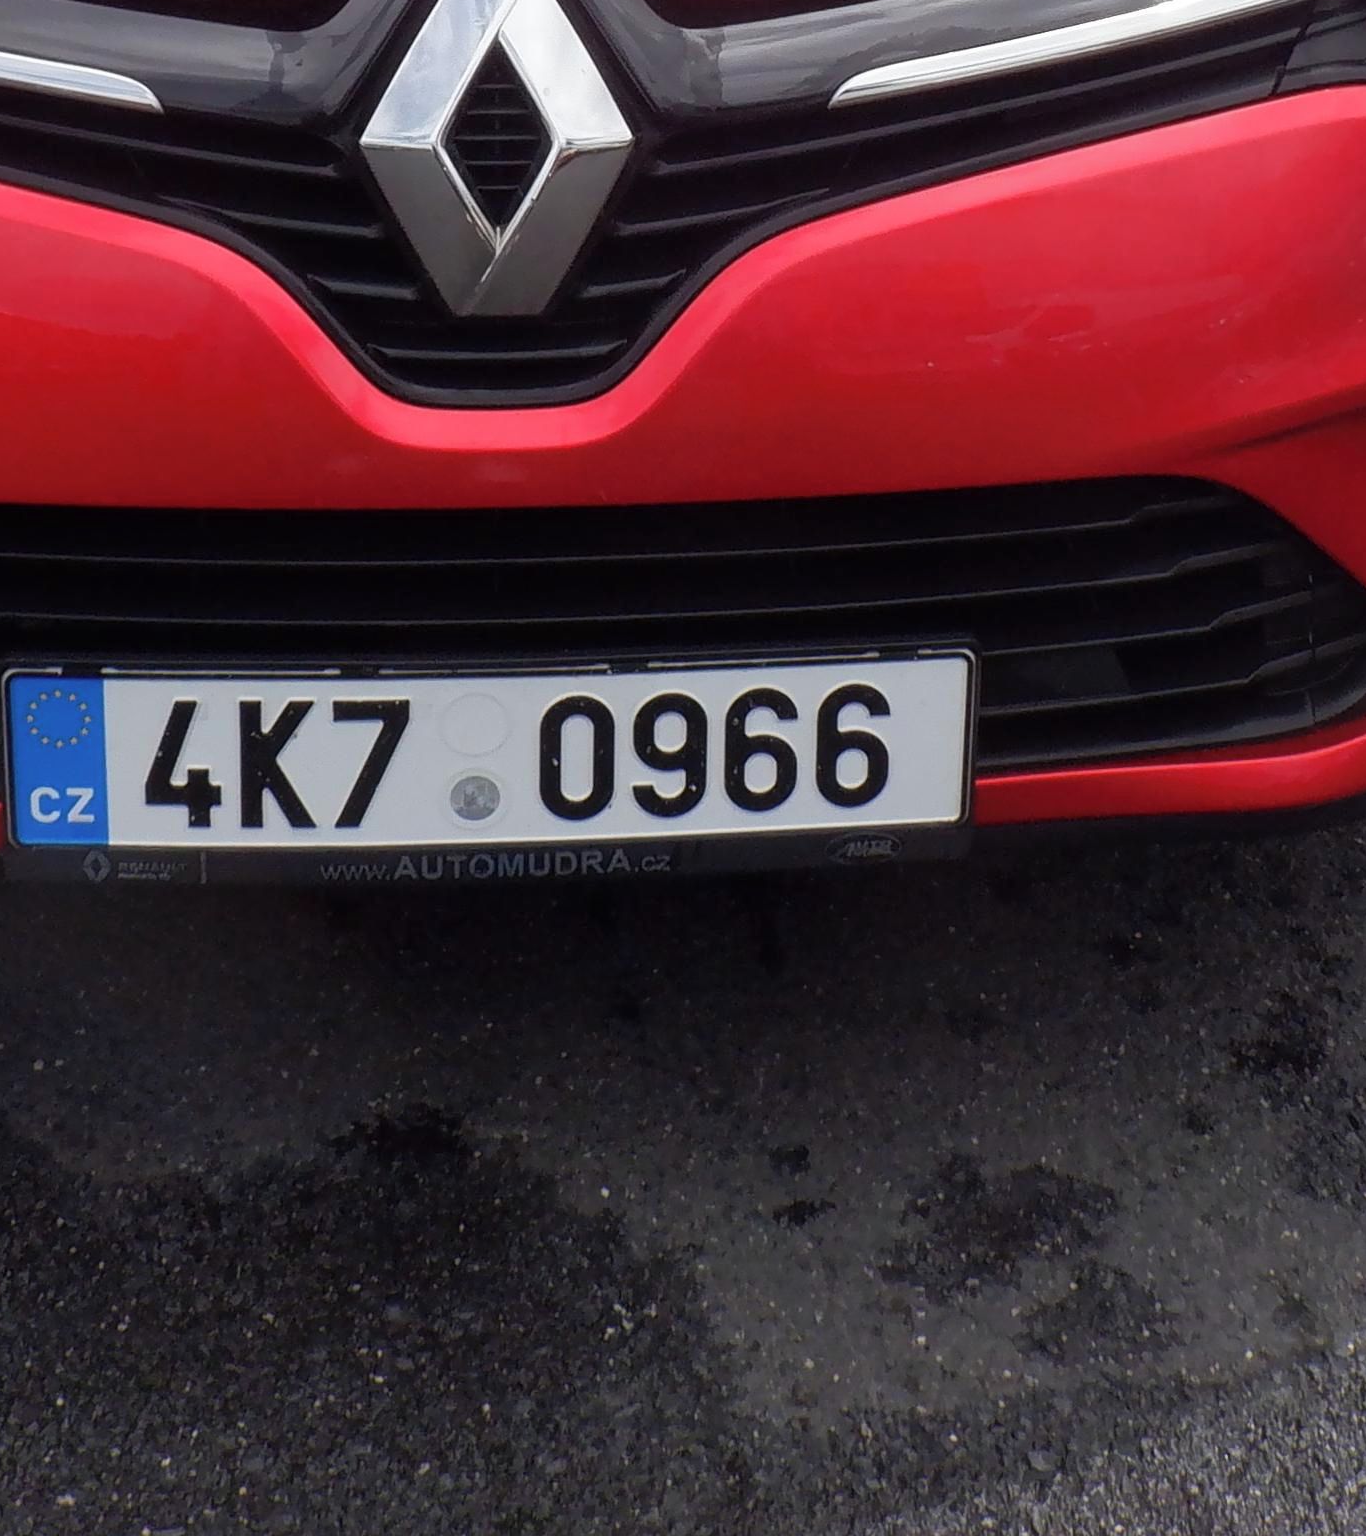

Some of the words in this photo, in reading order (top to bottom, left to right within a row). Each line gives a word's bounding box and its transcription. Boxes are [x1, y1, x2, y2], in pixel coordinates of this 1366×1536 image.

[29, 787, 95, 824] CZ
[145, 699, 411, 828] 4K7
[538, 682, 892, 821] 0966
